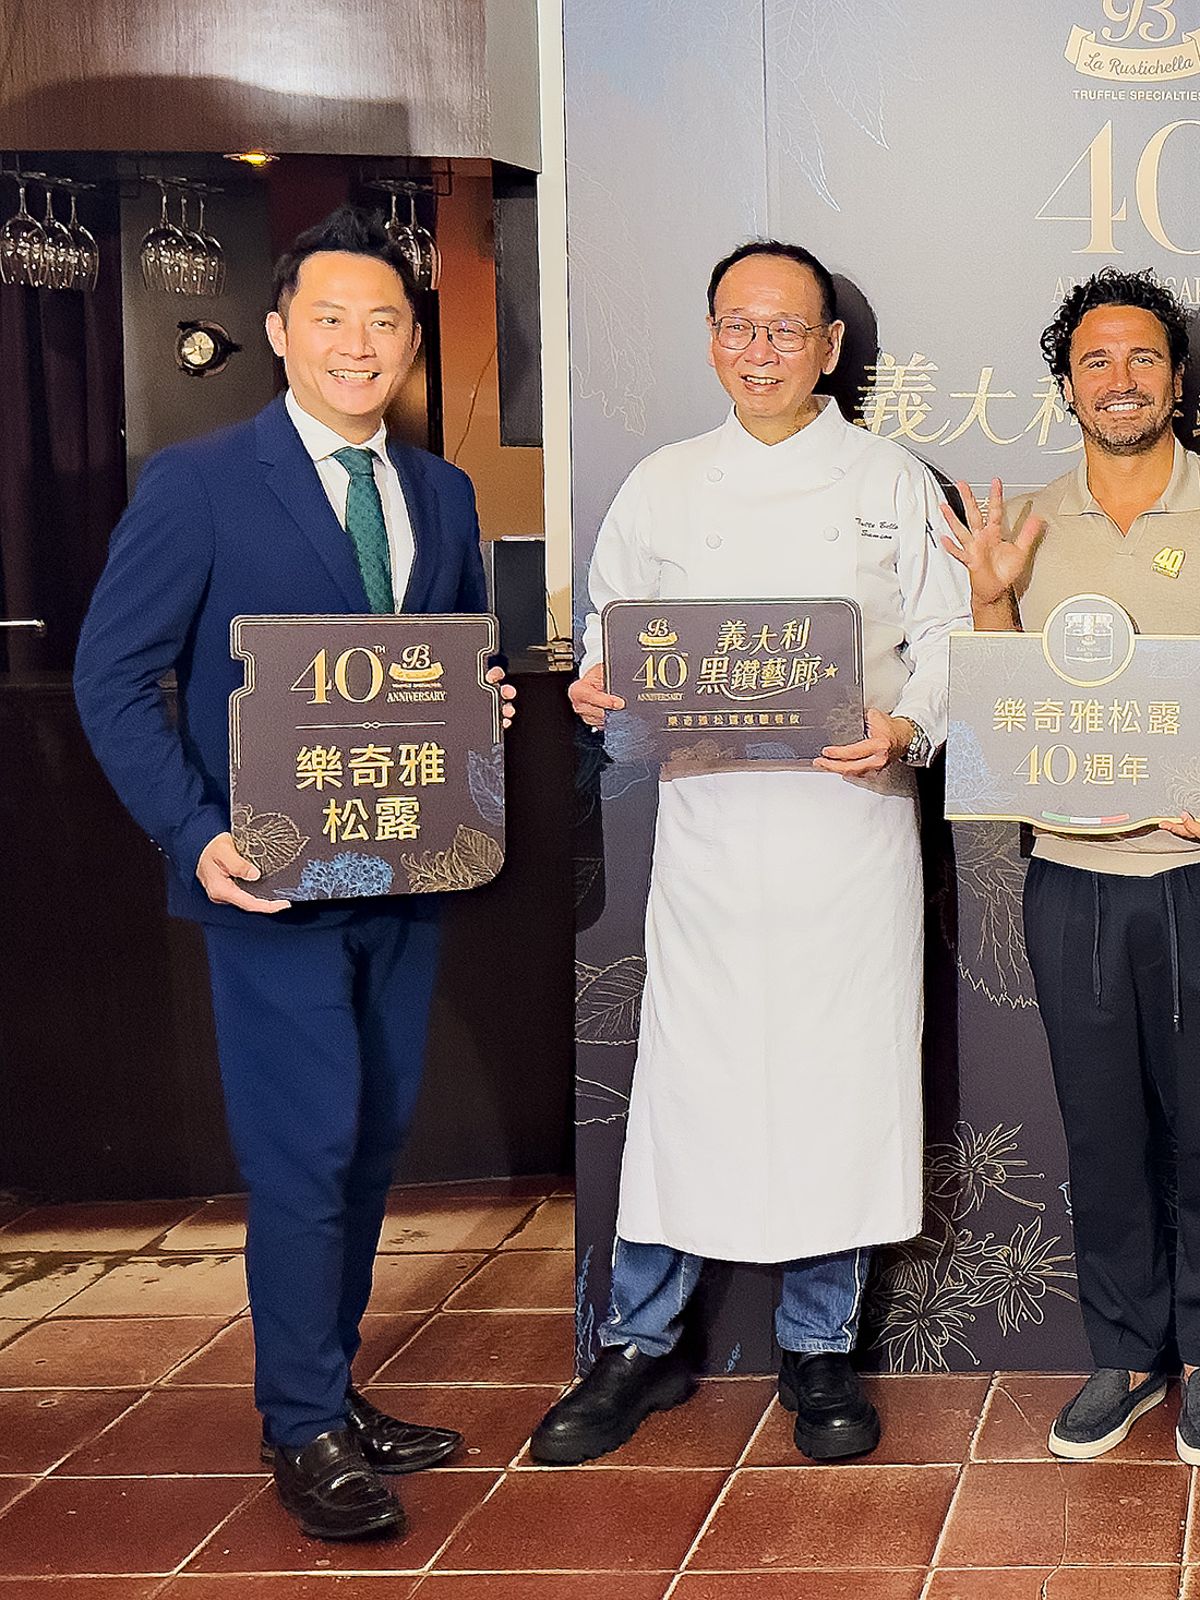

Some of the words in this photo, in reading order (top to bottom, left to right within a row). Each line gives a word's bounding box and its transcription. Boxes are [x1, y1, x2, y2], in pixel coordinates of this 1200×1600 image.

[1084, 52, 1104, 70] La
[1109, 55, 1195, 76] Rustichella
[1072, 90, 1125, 101] TRUFFLE
[714, 615, 812, 655] 義大利
[696, 653, 822, 700] 黑鑽藝廊
[992, 698, 1181, 735] 樂奇雅松露
[296, 741, 446, 791] 樂奇雅
[322, 795, 420, 843] 松露
